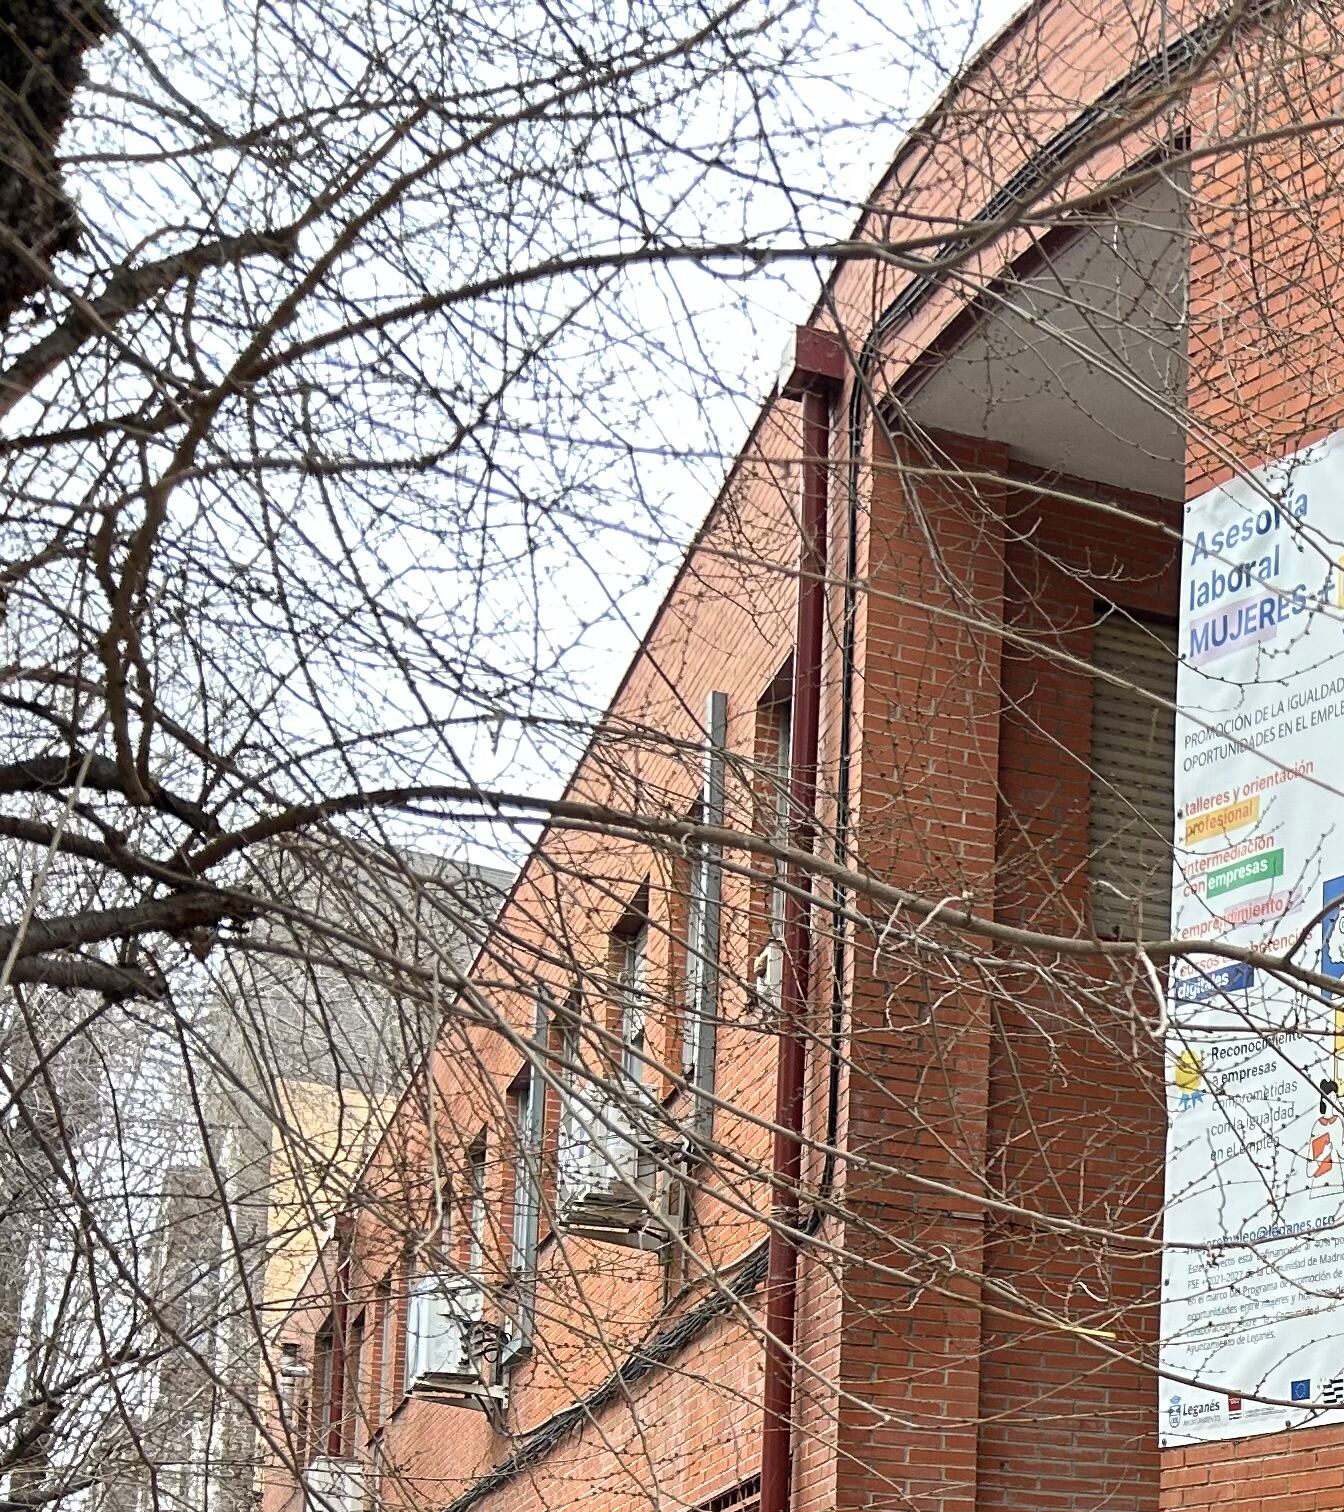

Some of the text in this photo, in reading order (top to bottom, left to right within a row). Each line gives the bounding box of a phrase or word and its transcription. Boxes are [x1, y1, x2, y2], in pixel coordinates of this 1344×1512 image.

[1188, 544, 1281, 612] laboral
[1188, 583, 1307, 659] MUJERES
[1182, 726, 1276, 773] OPORTUNIDADES
[1278, 719, 1293, 738] EN
[1295, 715, 1308, 733] EL
[1184, 713, 1253, 750] PROMOCIÓN
[1254, 706, 1270, 725] DE
[1270, 701, 1285, 718] LA
[1184, 760, 1315, 818] talleres y orientación
[1184, 804, 1253, 839] profesional
[1181, 833, 1275, 877] intermediación
[1182, 858, 1269, 897] con empresas
[1180, 898, 1284, 942] emprendimiento
[1221, 1060, 1278, 1085] empresas
[1210, 1101, 1296, 1137] con la igualdad
[1308, 1253, 1319, 1266] de
[1243, 1281, 1279, 1299] Programa
[1333, 1269, 1344, 1281] de
[1182, 1399, 1221, 1417] Leganés
